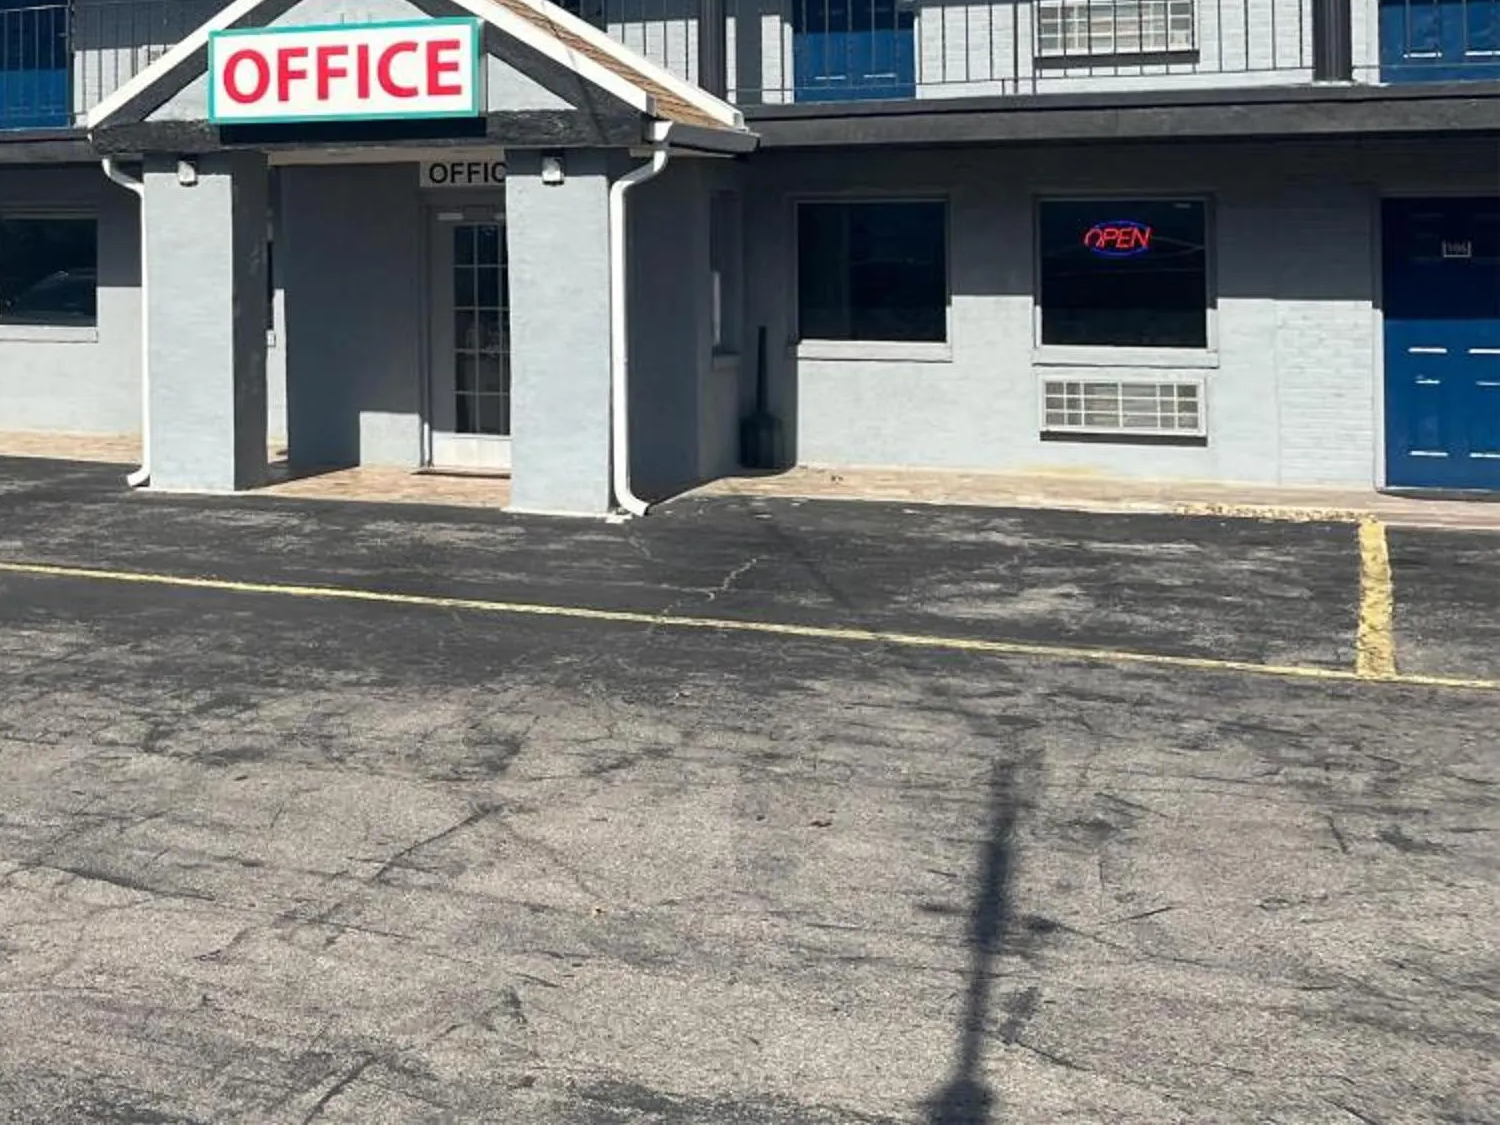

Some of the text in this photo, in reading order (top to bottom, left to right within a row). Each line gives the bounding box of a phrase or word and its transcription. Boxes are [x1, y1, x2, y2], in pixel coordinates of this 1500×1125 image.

[223, 40, 462, 104] OFFICE
[429, 162, 507, 184] OFFIC
[1084, 227, 1152, 249] OPEN
